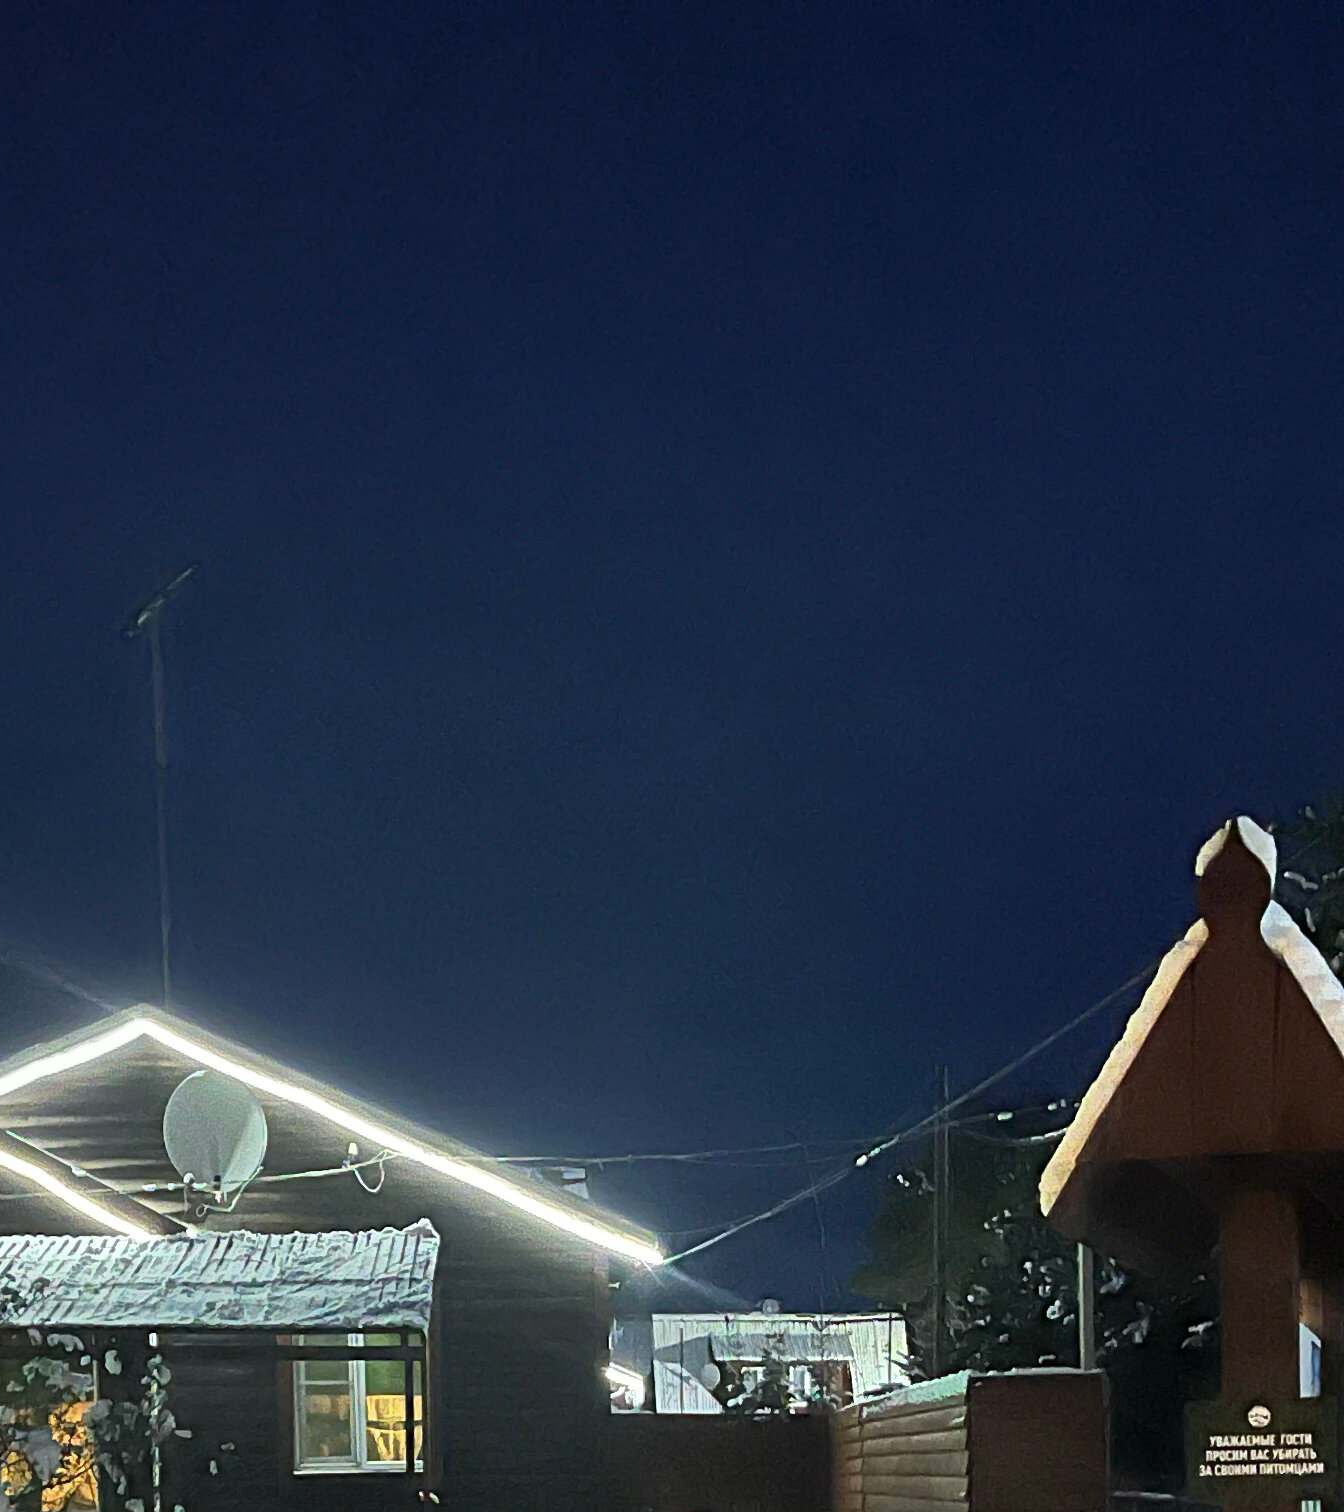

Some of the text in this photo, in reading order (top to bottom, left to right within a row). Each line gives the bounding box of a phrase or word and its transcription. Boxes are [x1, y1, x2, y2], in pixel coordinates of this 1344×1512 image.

[1210, 1433, 1312, 1447] УВАЖАЕМЫЕ ГОСТИ
[1205, 1448, 1317, 1462] ПРОСИМ ВАС УБИРАТЬ
[1199, 1463, 1324, 1477] ЗА СВОИМИ ПИТОМЦАМИ
